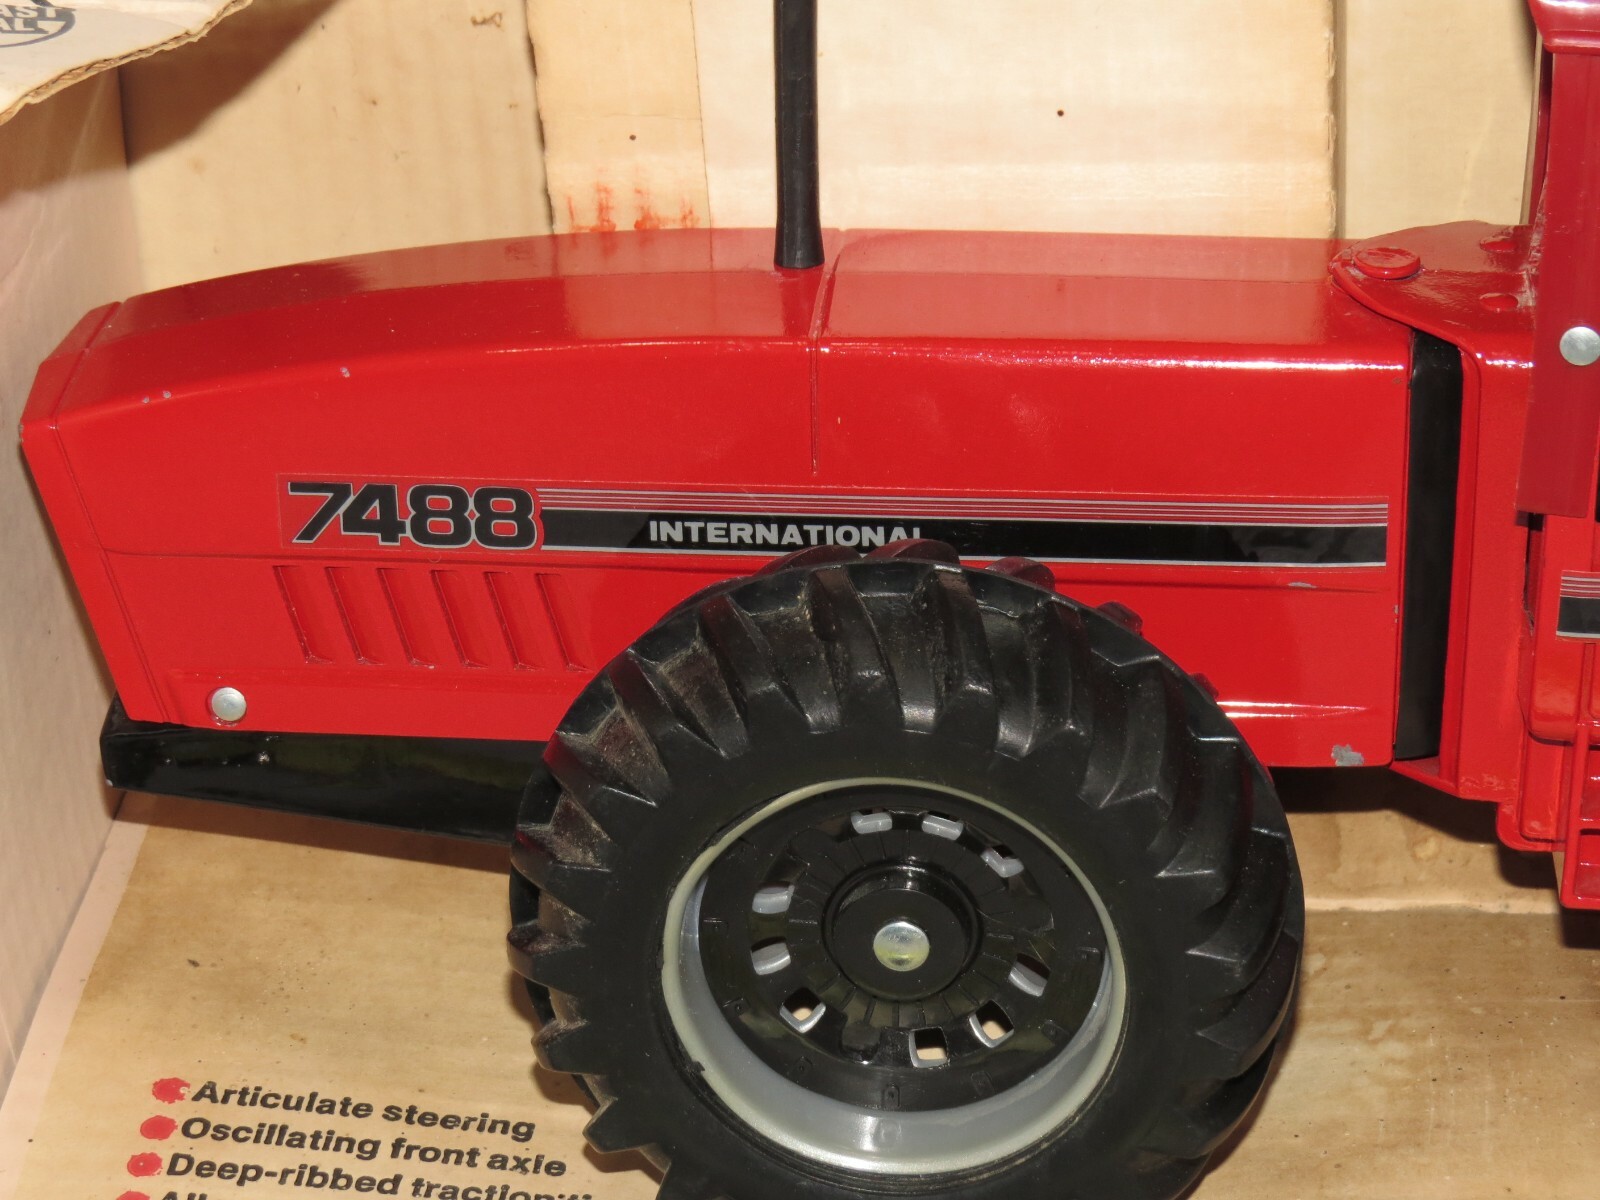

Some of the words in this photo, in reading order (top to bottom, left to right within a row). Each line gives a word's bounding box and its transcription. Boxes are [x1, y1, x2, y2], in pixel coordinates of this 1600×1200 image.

[288, 481, 538, 550] 7488
[191, 1080, 374, 1119] Articulate
[382, 1104, 536, 1143] steering
[166, 1152, 404, 1195] Deep-ribbed
[181, 1116, 382, 1161] Oscillating
[390, 1137, 481, 1168] front
[487, 1153, 567, 1177] axle
